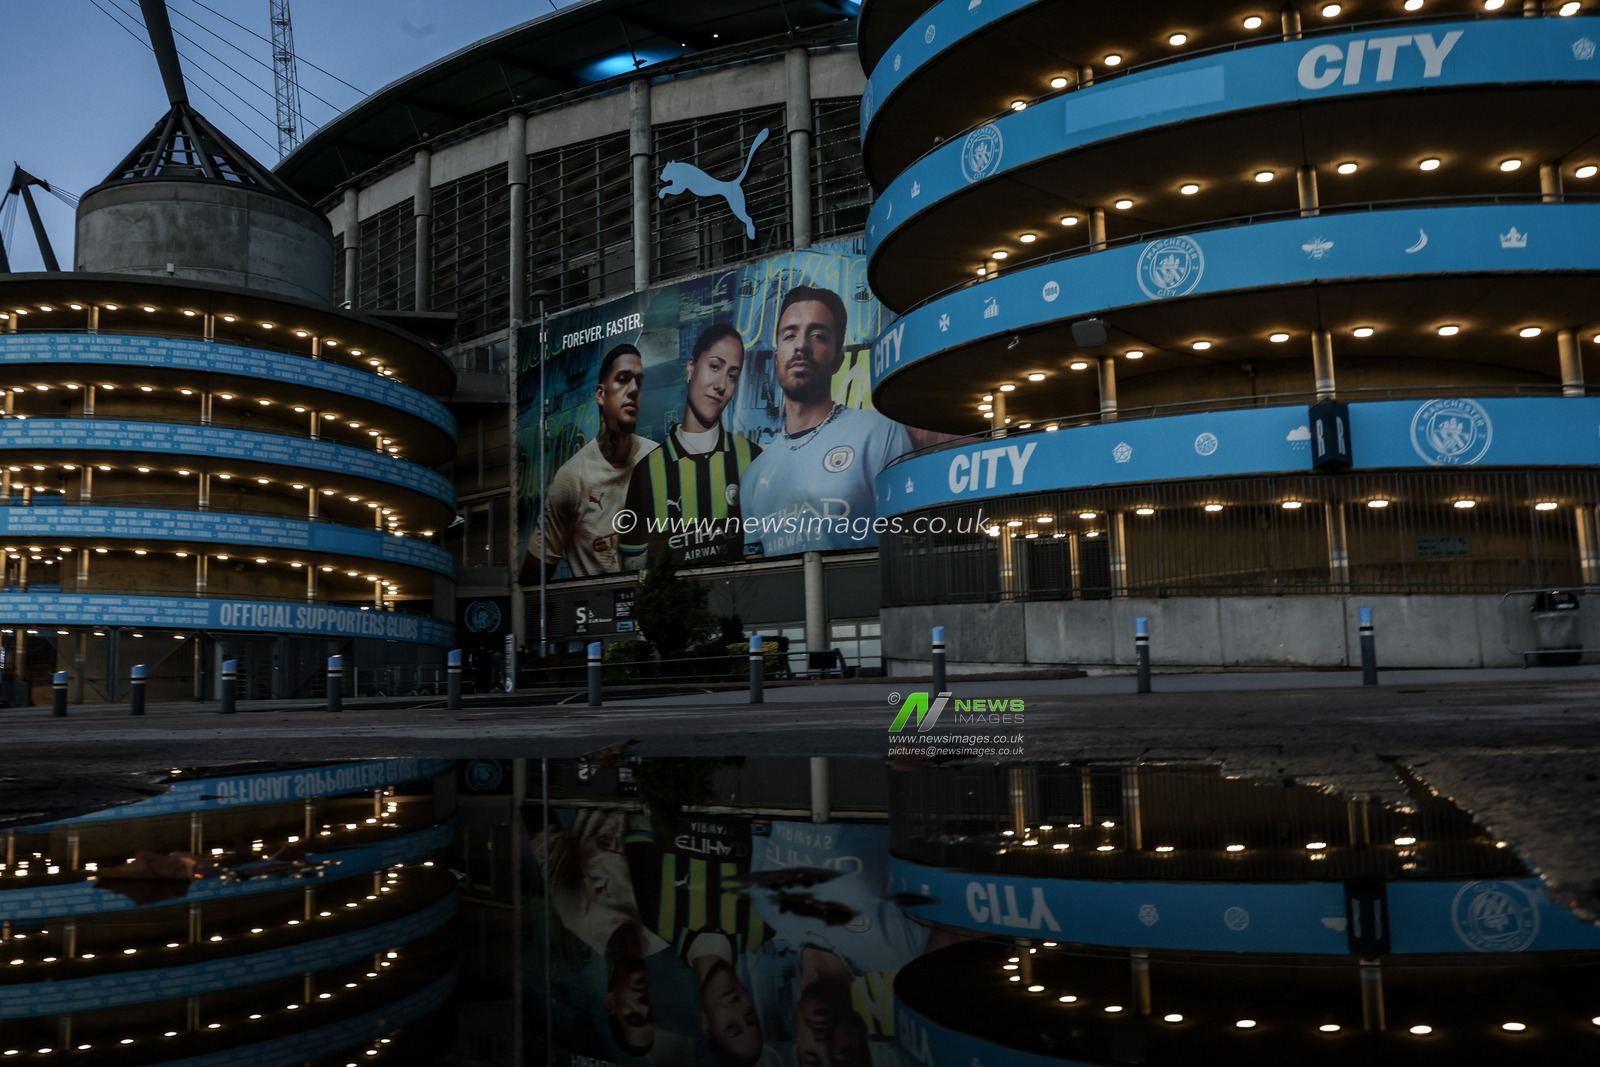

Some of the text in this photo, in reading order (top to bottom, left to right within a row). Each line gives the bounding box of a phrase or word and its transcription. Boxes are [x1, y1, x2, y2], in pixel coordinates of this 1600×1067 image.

[1297, 30, 1464, 91] CITY
[966, 127, 999, 149] MANCHESTER
[973, 172, 986, 180] CITY
[1145, 238, 1198, 261] MANCHESTER
[1157, 289, 1177, 297] CITY
[562, 312, 644, 350] FOREVER. FASTER.
[874, 321, 906, 379] CITY
[1422, 399, 1485, 428] MANCHESTER
[1315, 418, 1327, 458] R
[1335, 416, 1347, 455] R
[948, 440, 1038, 494] CITY
[1435, 454, 1460, 464] CITY
[219, 602, 293, 628] OFFICIAL
[296, 606, 385, 636] SUPPORTERS
[386, 615, 418, 640] CLUBS
[575, 606, 587, 625] S
